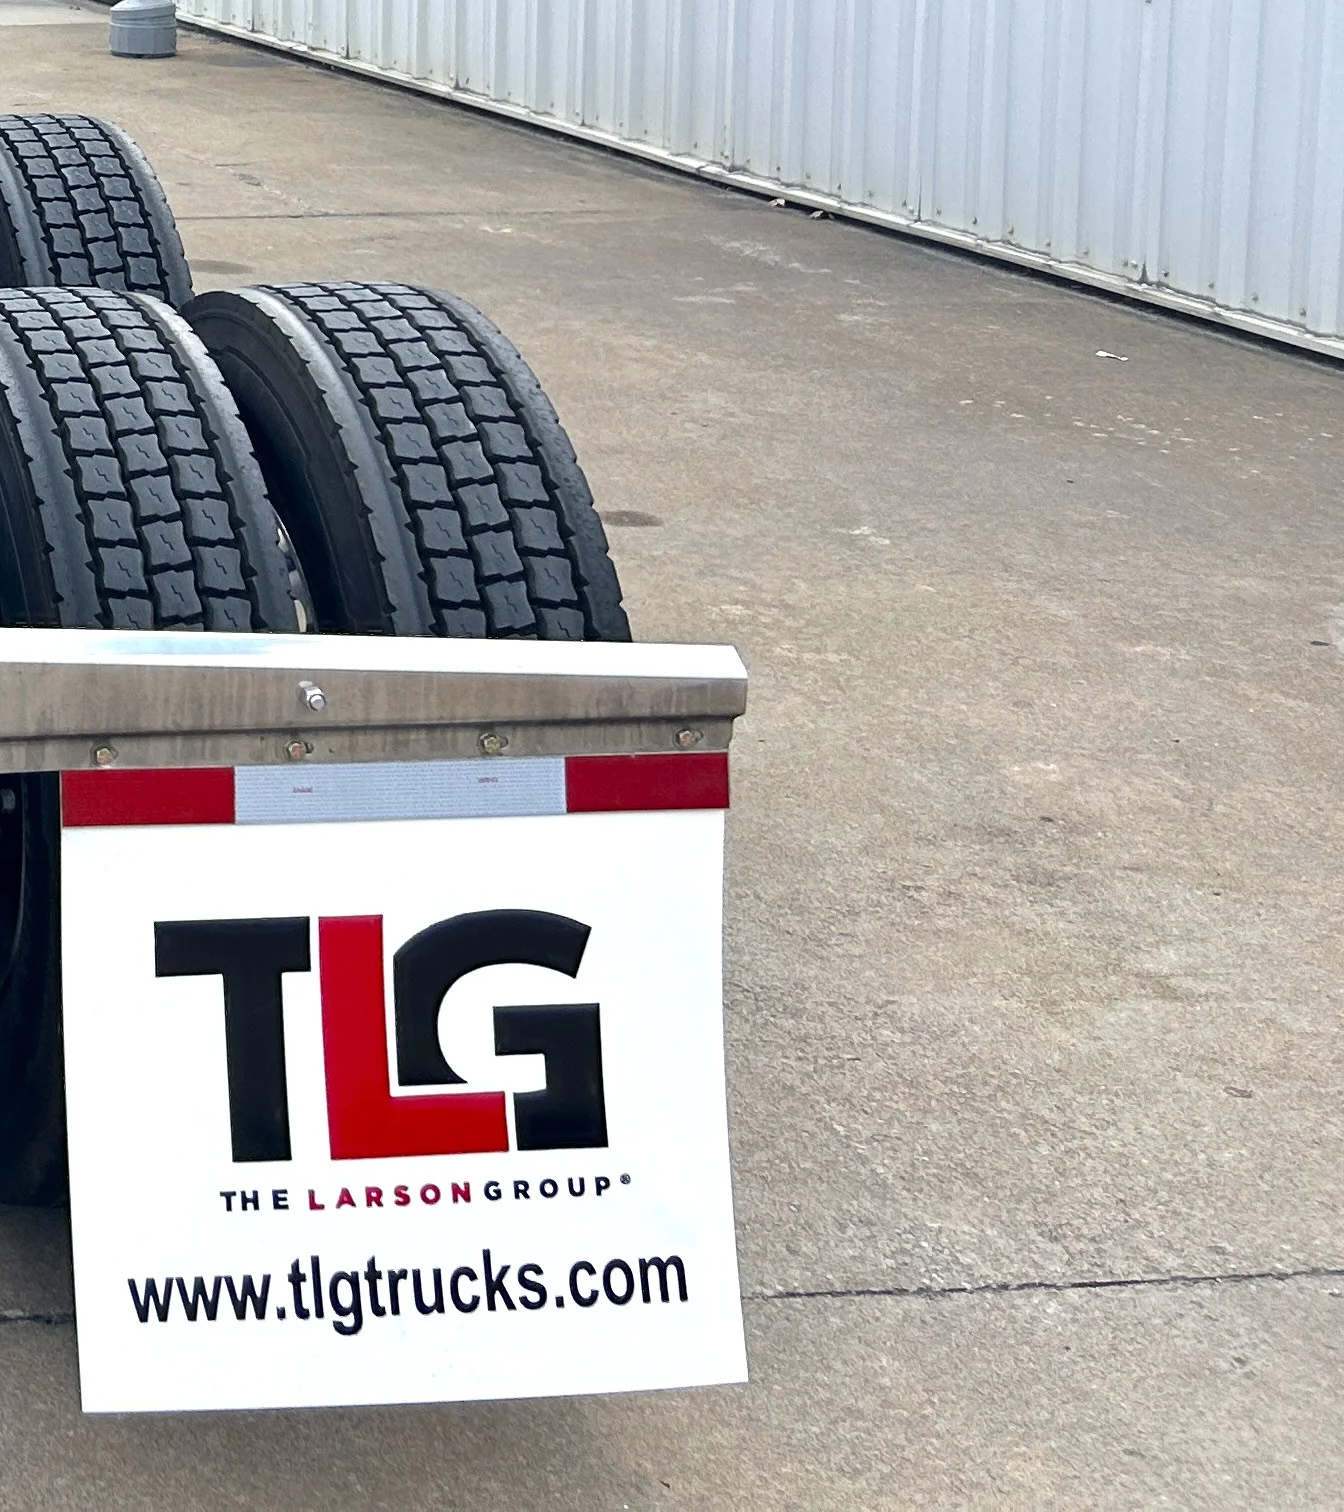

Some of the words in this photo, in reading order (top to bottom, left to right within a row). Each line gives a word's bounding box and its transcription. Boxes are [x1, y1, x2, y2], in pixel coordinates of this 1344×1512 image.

[154, 909, 608, 1163] TLG
[220, 1189, 289, 1211] THE
[128, 1249, 689, 1336] www.tlgtrucks.com
